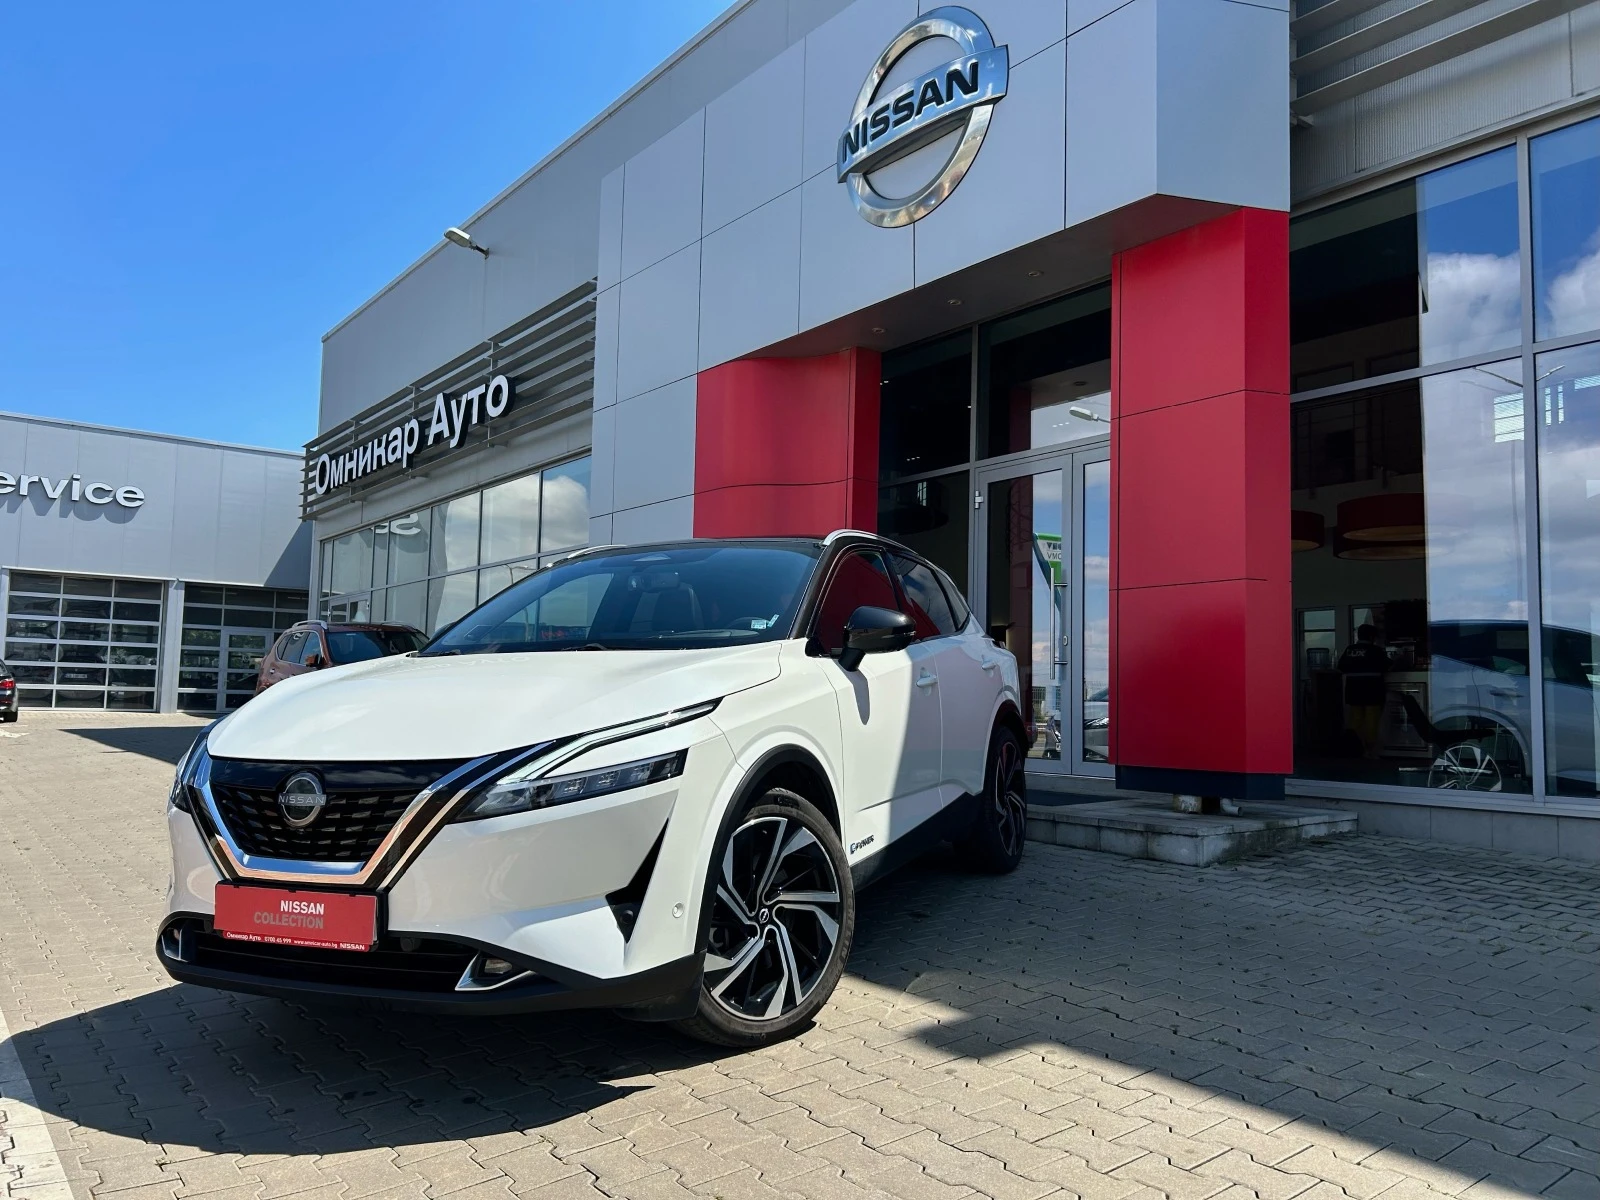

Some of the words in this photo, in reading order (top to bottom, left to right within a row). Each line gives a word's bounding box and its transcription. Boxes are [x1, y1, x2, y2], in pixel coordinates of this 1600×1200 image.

[842, 61, 979, 164] NISSAN
[315, 418, 420, 495] Омникар
[427, 374, 509, 449] Ауто
[278, 795, 325, 805] NISSAN
[280, 900, 325, 915] NISSAN
[253, 911, 324, 930] COLLECTION
[339, 942, 365, 950] NISSAN
